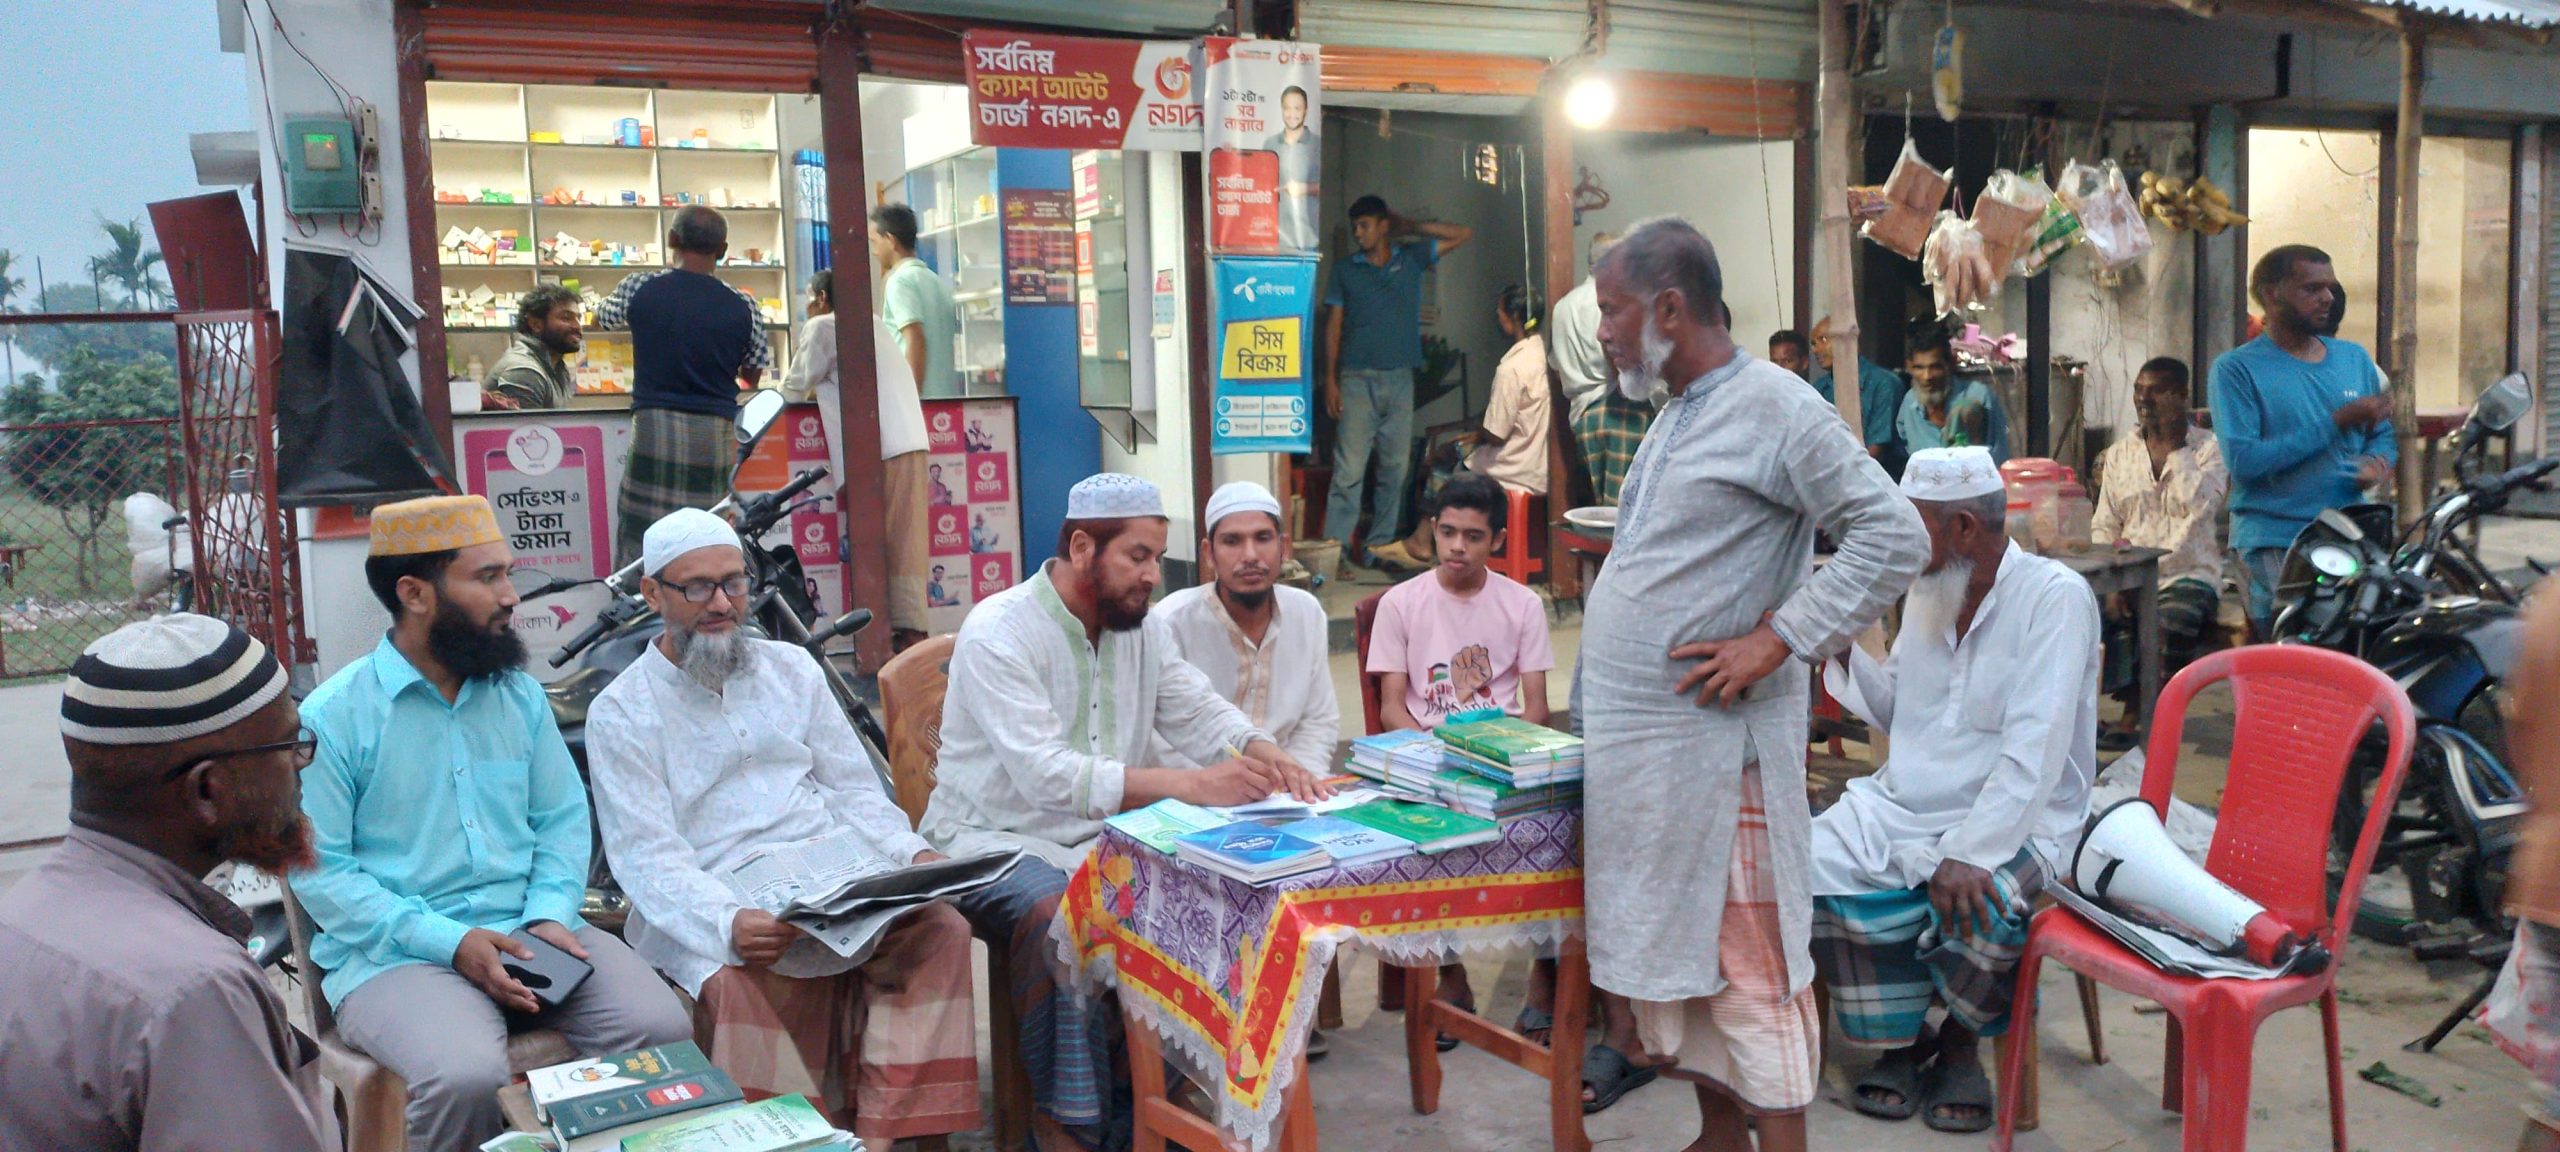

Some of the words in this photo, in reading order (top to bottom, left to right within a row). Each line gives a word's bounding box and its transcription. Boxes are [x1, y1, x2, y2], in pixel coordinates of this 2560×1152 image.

[974, 40, 1055, 74] সর্বনিম্ন
[976, 74, 1038, 98] ক্যাশ
[1041, 71, 1109, 101] আউট
[1039, 104, 1121, 129] নগদ-এ
[1147, 103, 1204, 127] নগদ
[1253, 324, 1285, 350] সিম
[1237, 348, 1287, 373] বিক্রয়
[515, 510, 564, 531] টাকা
[511, 531, 571, 550] জমান
